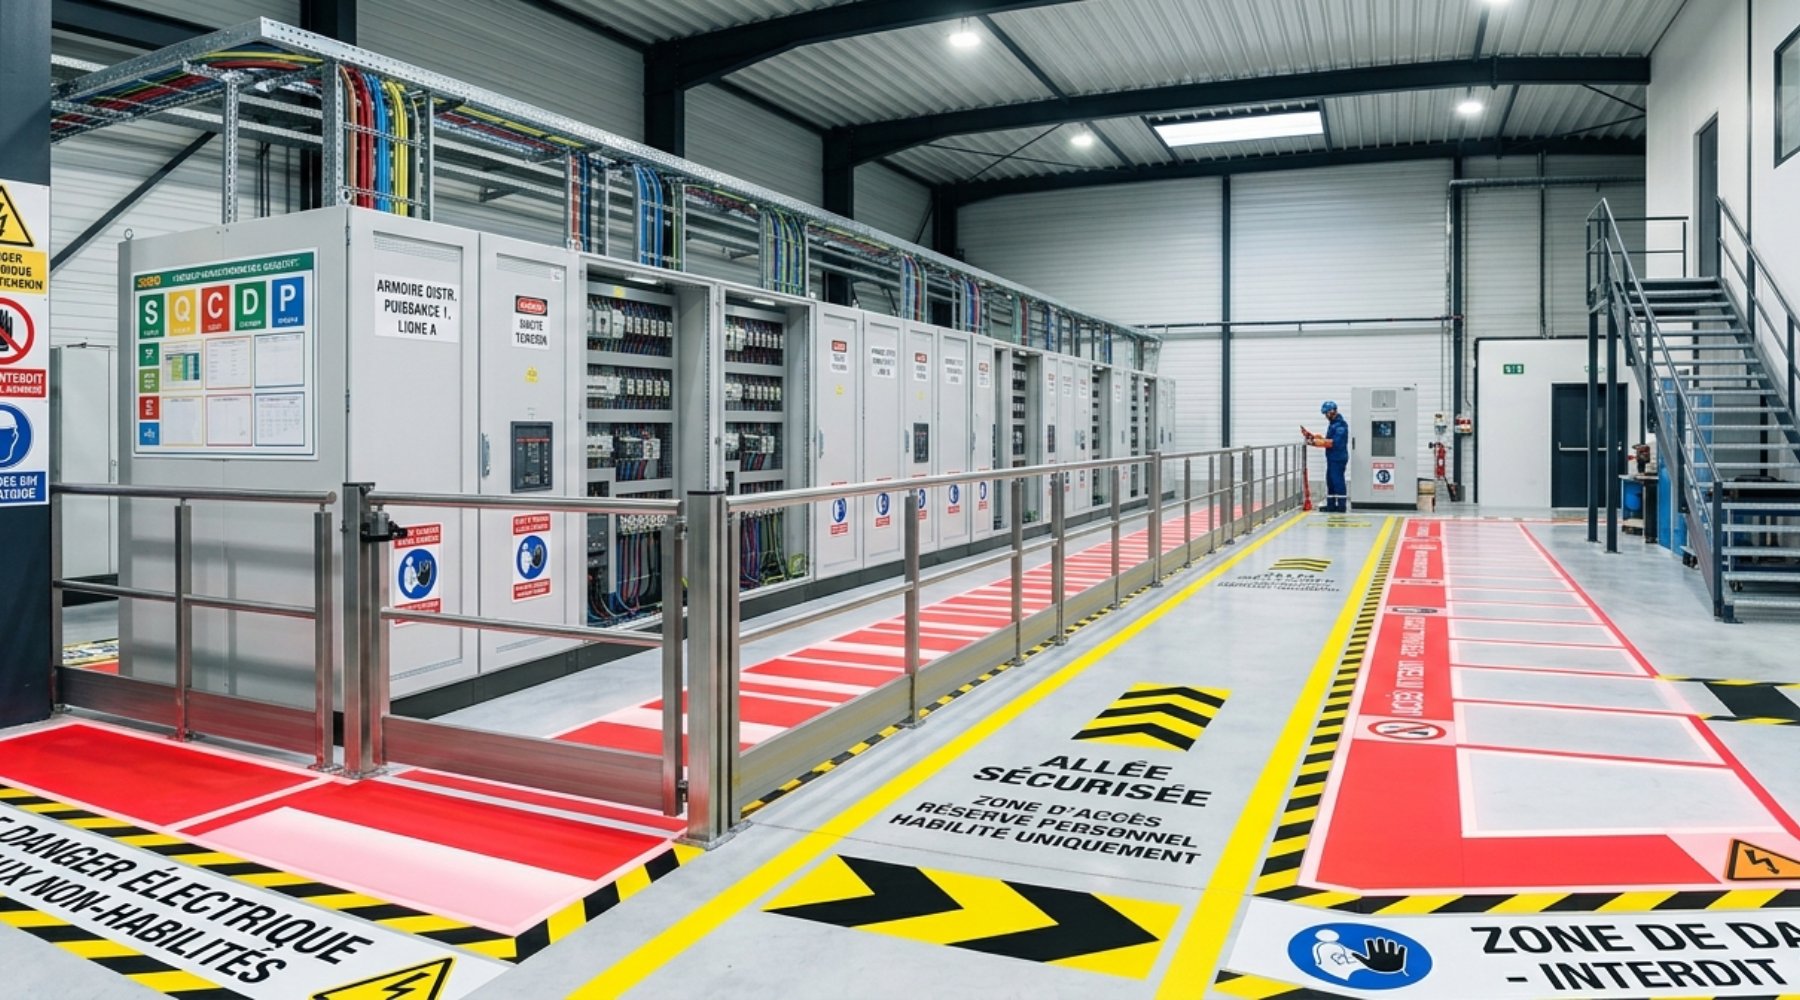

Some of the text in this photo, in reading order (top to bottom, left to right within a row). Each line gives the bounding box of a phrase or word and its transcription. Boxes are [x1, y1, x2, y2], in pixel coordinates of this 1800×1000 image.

[145, 284, 296, 325] S Q C D P
[377, 279, 424, 298] ARMOIRE
[429, 323, 437, 336] A
[1038, 755, 1173, 781] ALLÉE
[972, 795, 1043, 813] ZONE
[973, 766, 1212, 808] SÉCURISÉE
[888, 813, 1202, 865] HABILITE UNIQUEMENT
[915, 801, 1199, 849] RÉSERVE PERSONNEL
[0, 825, 375, 966] DANGER ÉLECTRIQUE
[19, 875, 288, 985] NON-HABILITÉS
[1470, 924, 1636, 955] ZONE
[1635, 922, 1730, 952] DE
[1538, 957, 1789, 991] INTERDIT
